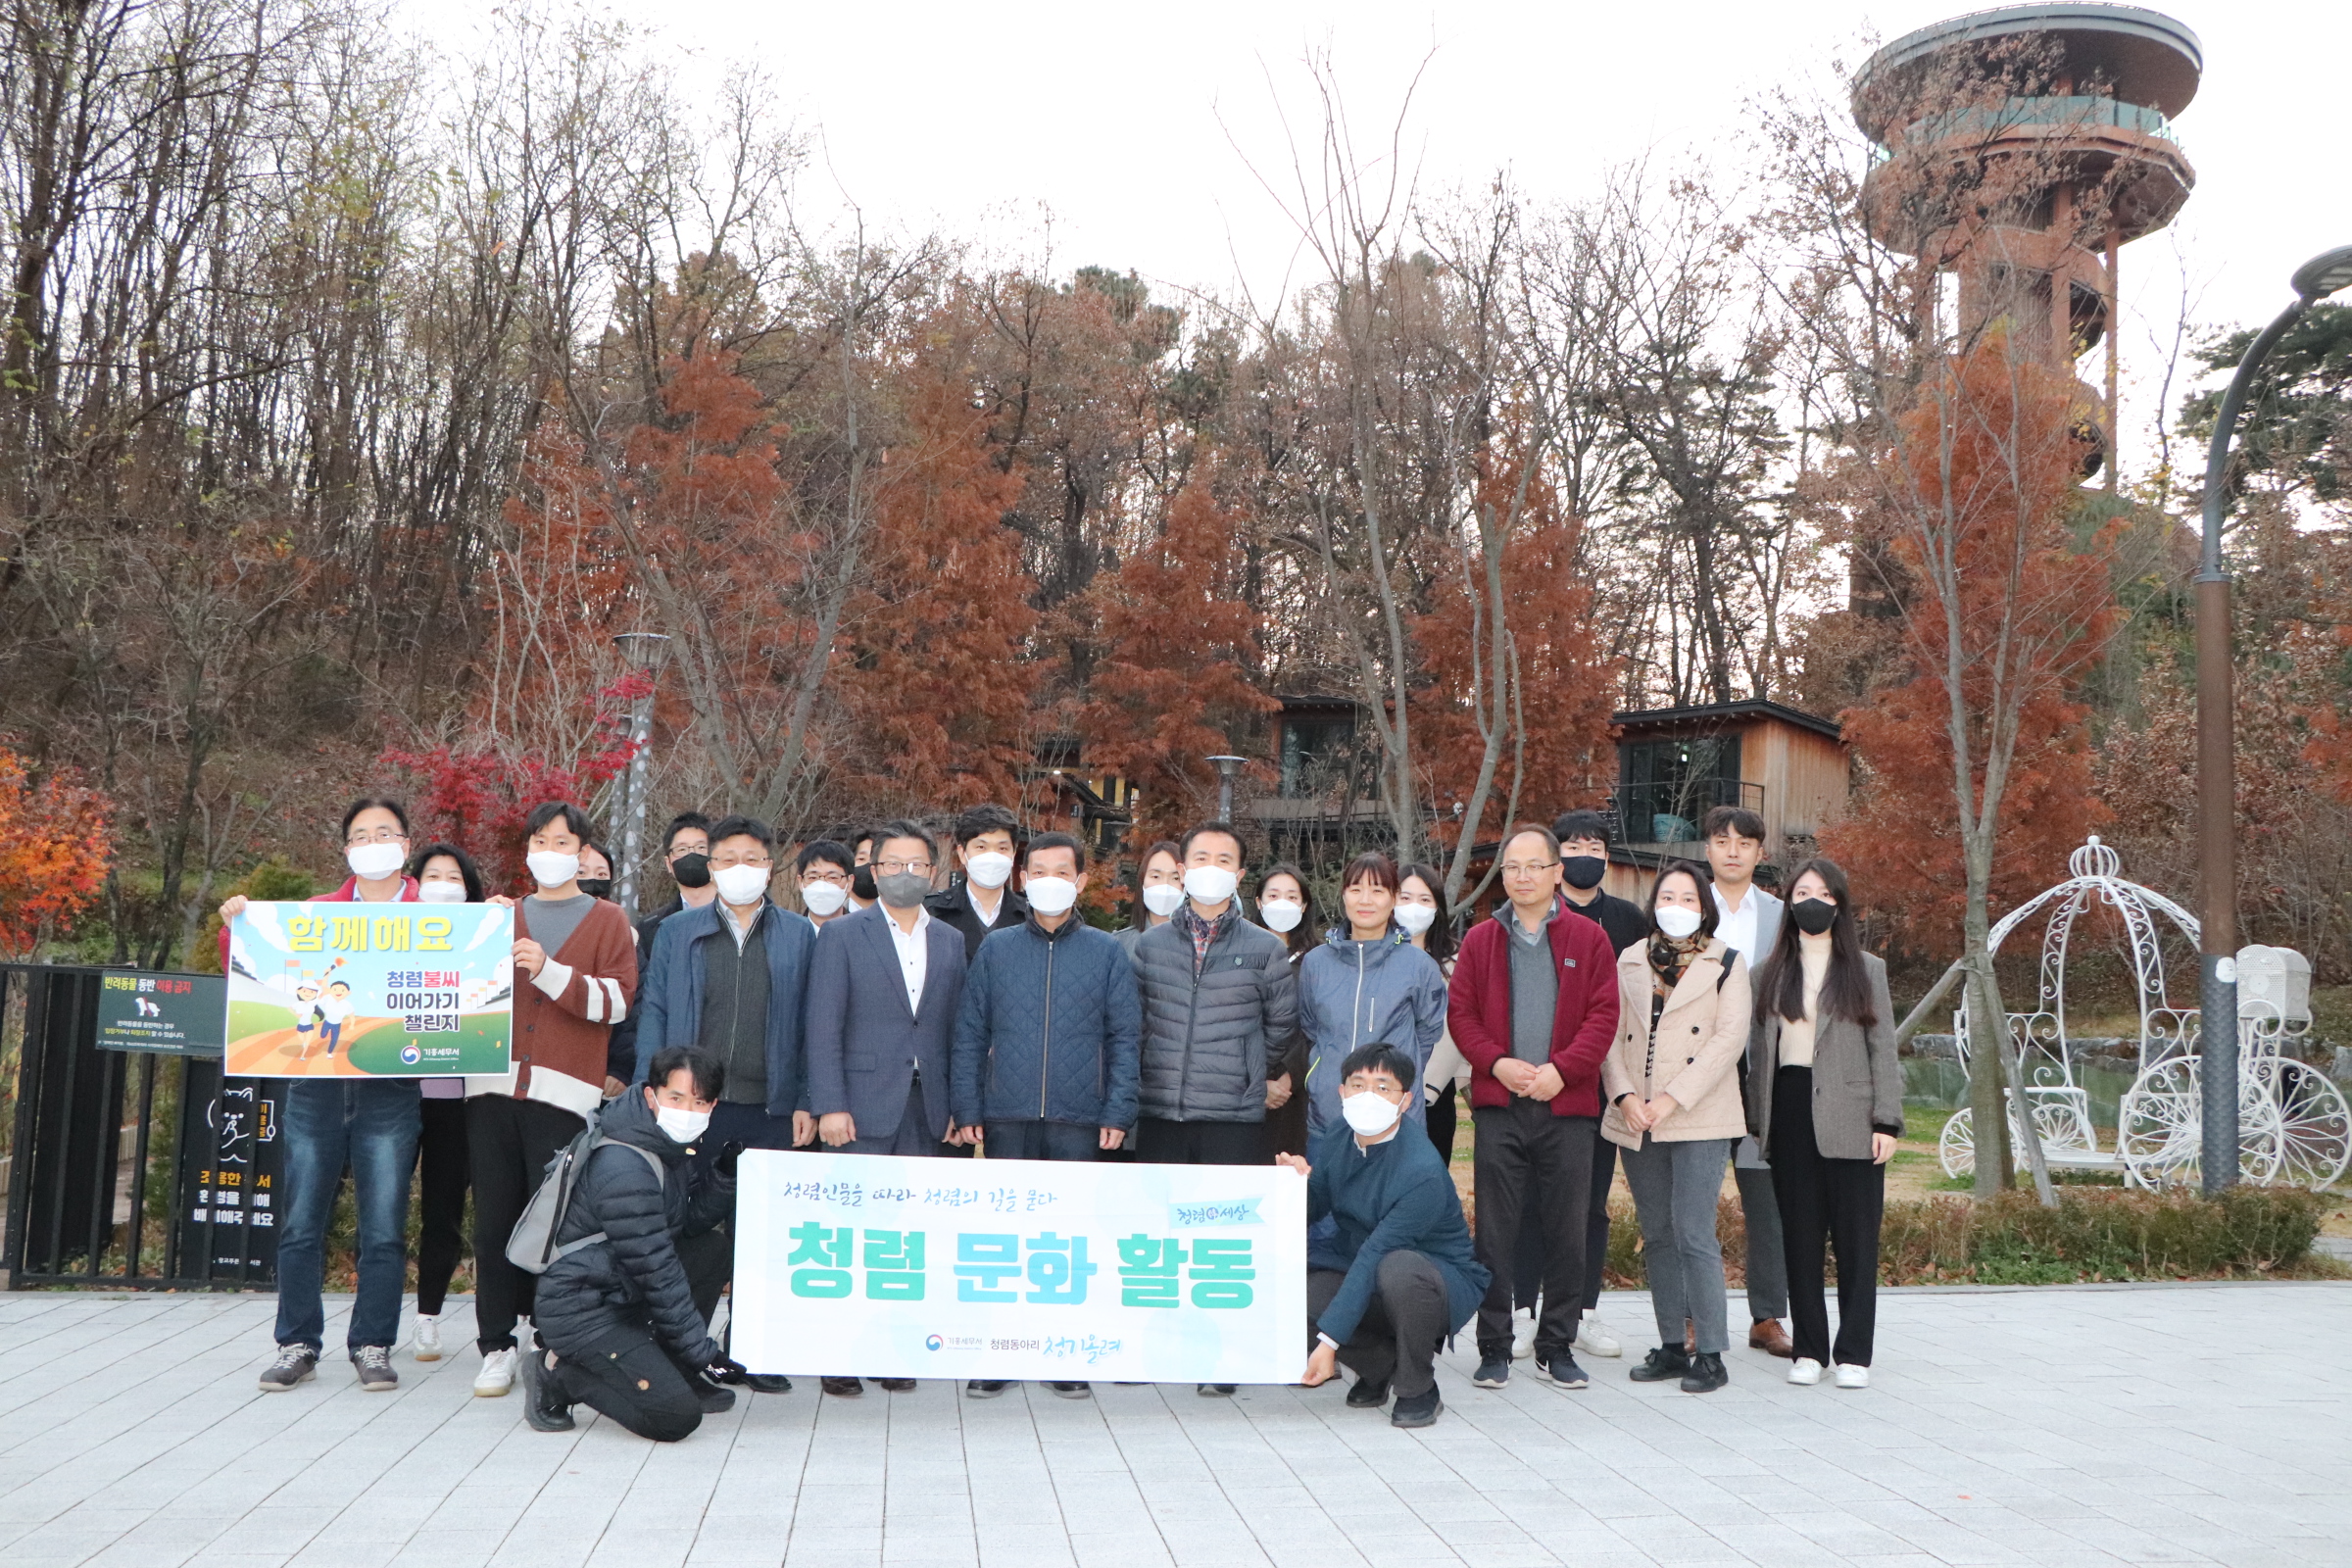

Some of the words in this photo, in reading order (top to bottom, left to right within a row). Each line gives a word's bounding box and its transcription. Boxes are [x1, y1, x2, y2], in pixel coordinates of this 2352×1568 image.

[287, 915, 453, 952] 함께해요
[105, 976, 137, 991] 반려동물
[138, 978, 156, 992] 동반
[156, 979, 173, 993] 이용
[174, 980, 192, 994] 금지
[386, 970, 461, 988] 청렴불씨
[386, 992, 460, 1009] 이어가기
[404, 1013, 460, 1032] 챌린지
[423, 1048, 460, 1056] 기흥세무서
[784, 1182, 863, 1207] 청렴인물을
[872, 1188, 917, 1200] 따라
[924, 1188, 979, 1206] 청렴의
[988, 1188, 1017, 1212] 길을
[1026, 1189, 1058, 1211] 묻다
[787, 1221, 927, 1301] 청렴
[953, 1231, 1098, 1305] 문화
[1116, 1233, 1256, 1309] 활동
[948, 1337, 983, 1346] 기흥세무서
[990, 1339, 1040, 1350] 청렴동아리
[1043, 1334, 1121, 1365] 청기올려
